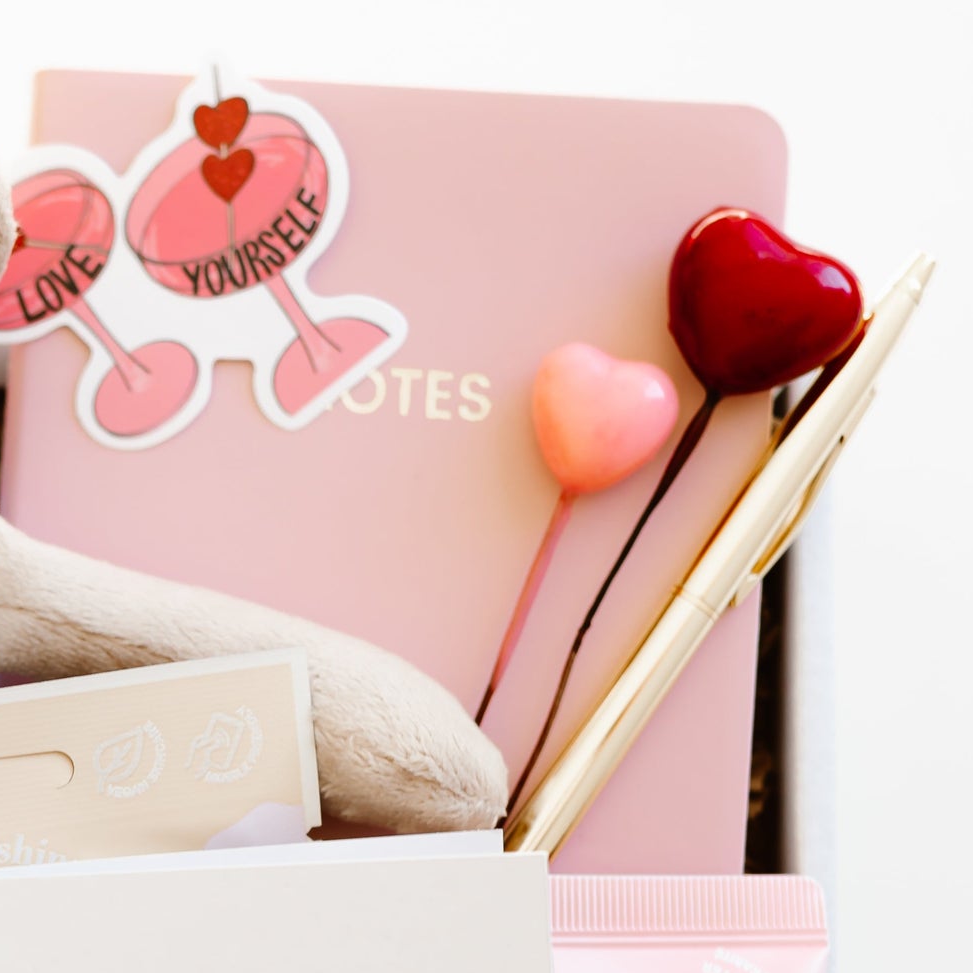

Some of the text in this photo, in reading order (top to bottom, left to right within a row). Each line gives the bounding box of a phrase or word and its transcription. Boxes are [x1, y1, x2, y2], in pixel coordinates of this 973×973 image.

[183, 187, 326, 297] YOURSELF
[16, 244, 103, 323] LOVE
[327, 367, 492, 422] OTES
